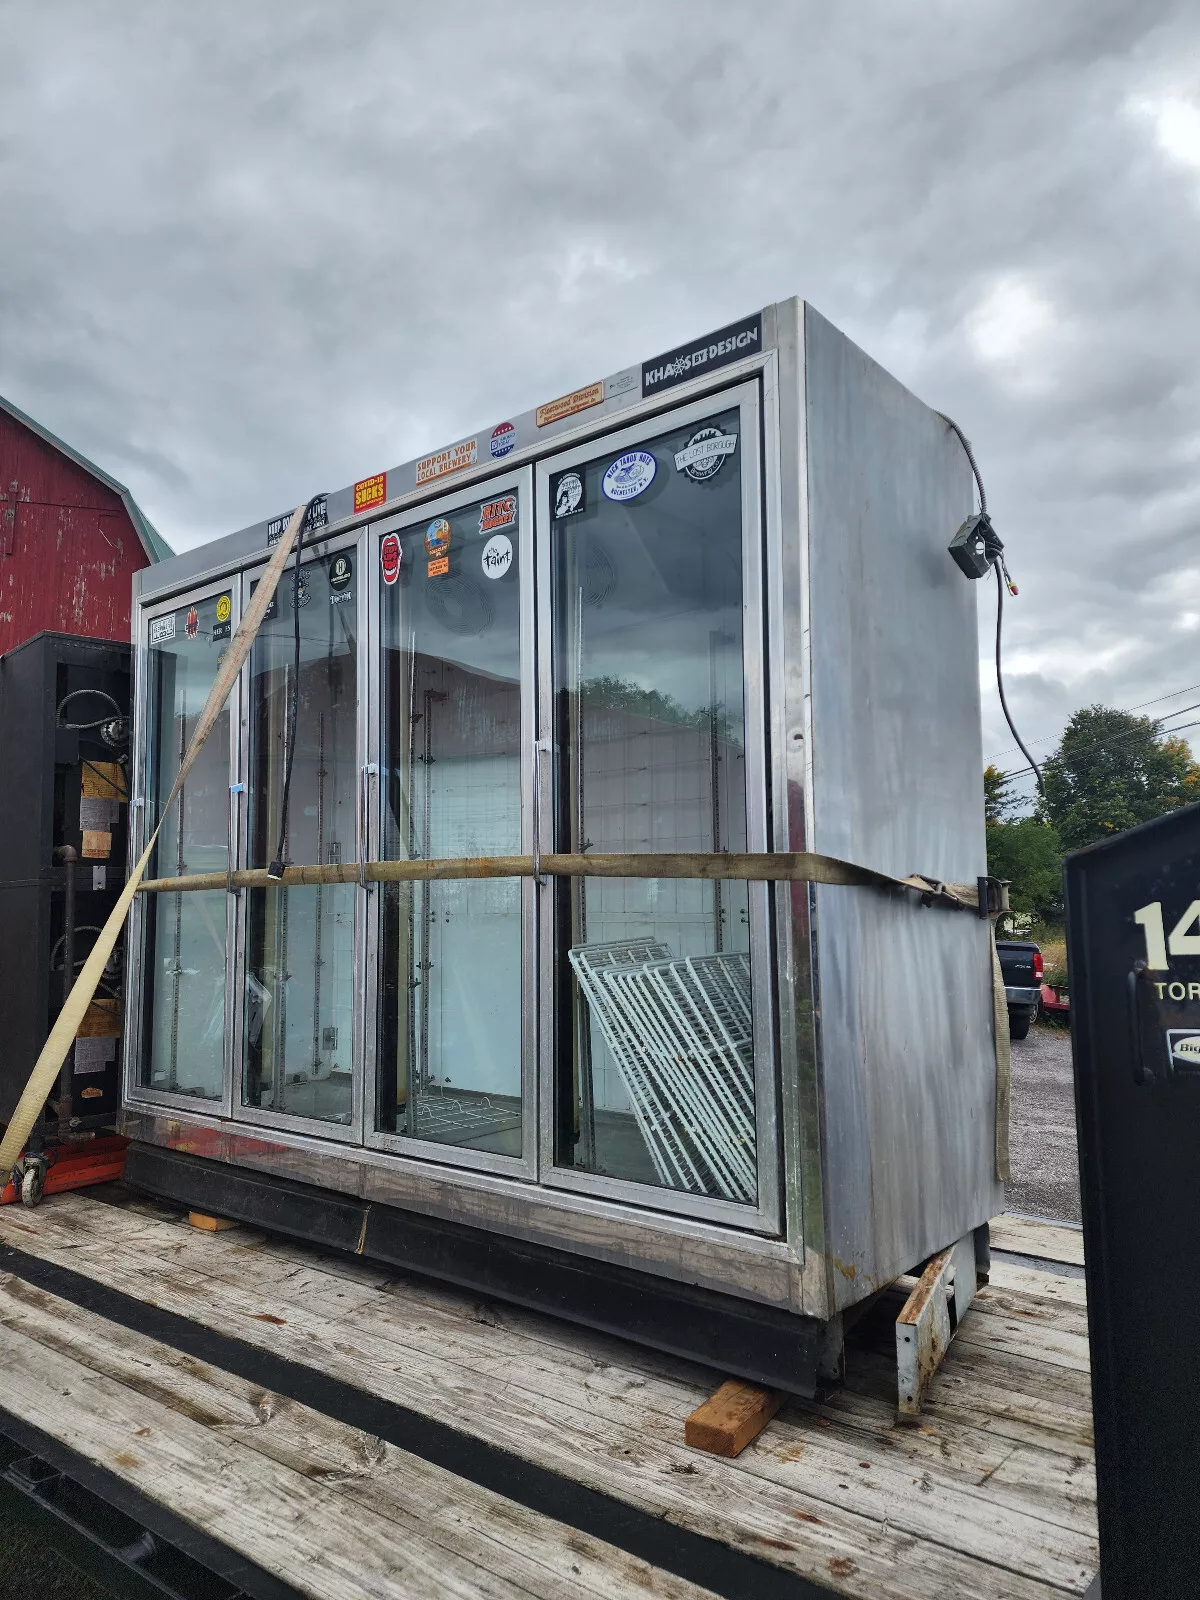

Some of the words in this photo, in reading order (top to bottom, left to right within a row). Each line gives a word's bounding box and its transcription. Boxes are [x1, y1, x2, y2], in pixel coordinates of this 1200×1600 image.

[709, 327, 758, 359] DESIGN
[417, 450, 451, 472] SUPPORT
[454, 440, 476, 456] YOUR
[675, 453, 688, 464] THE
[706, 440, 735, 454] BOROUGH
[417, 468, 437, 481] LOCAL
[439, 453, 471, 472] BREWERY
[355, 483, 384, 505] SUCKS
[483, 550, 511, 572] taint
[1134, 899, 1200, 970] 14
[1154, 982, 1200, 1000] TOR
